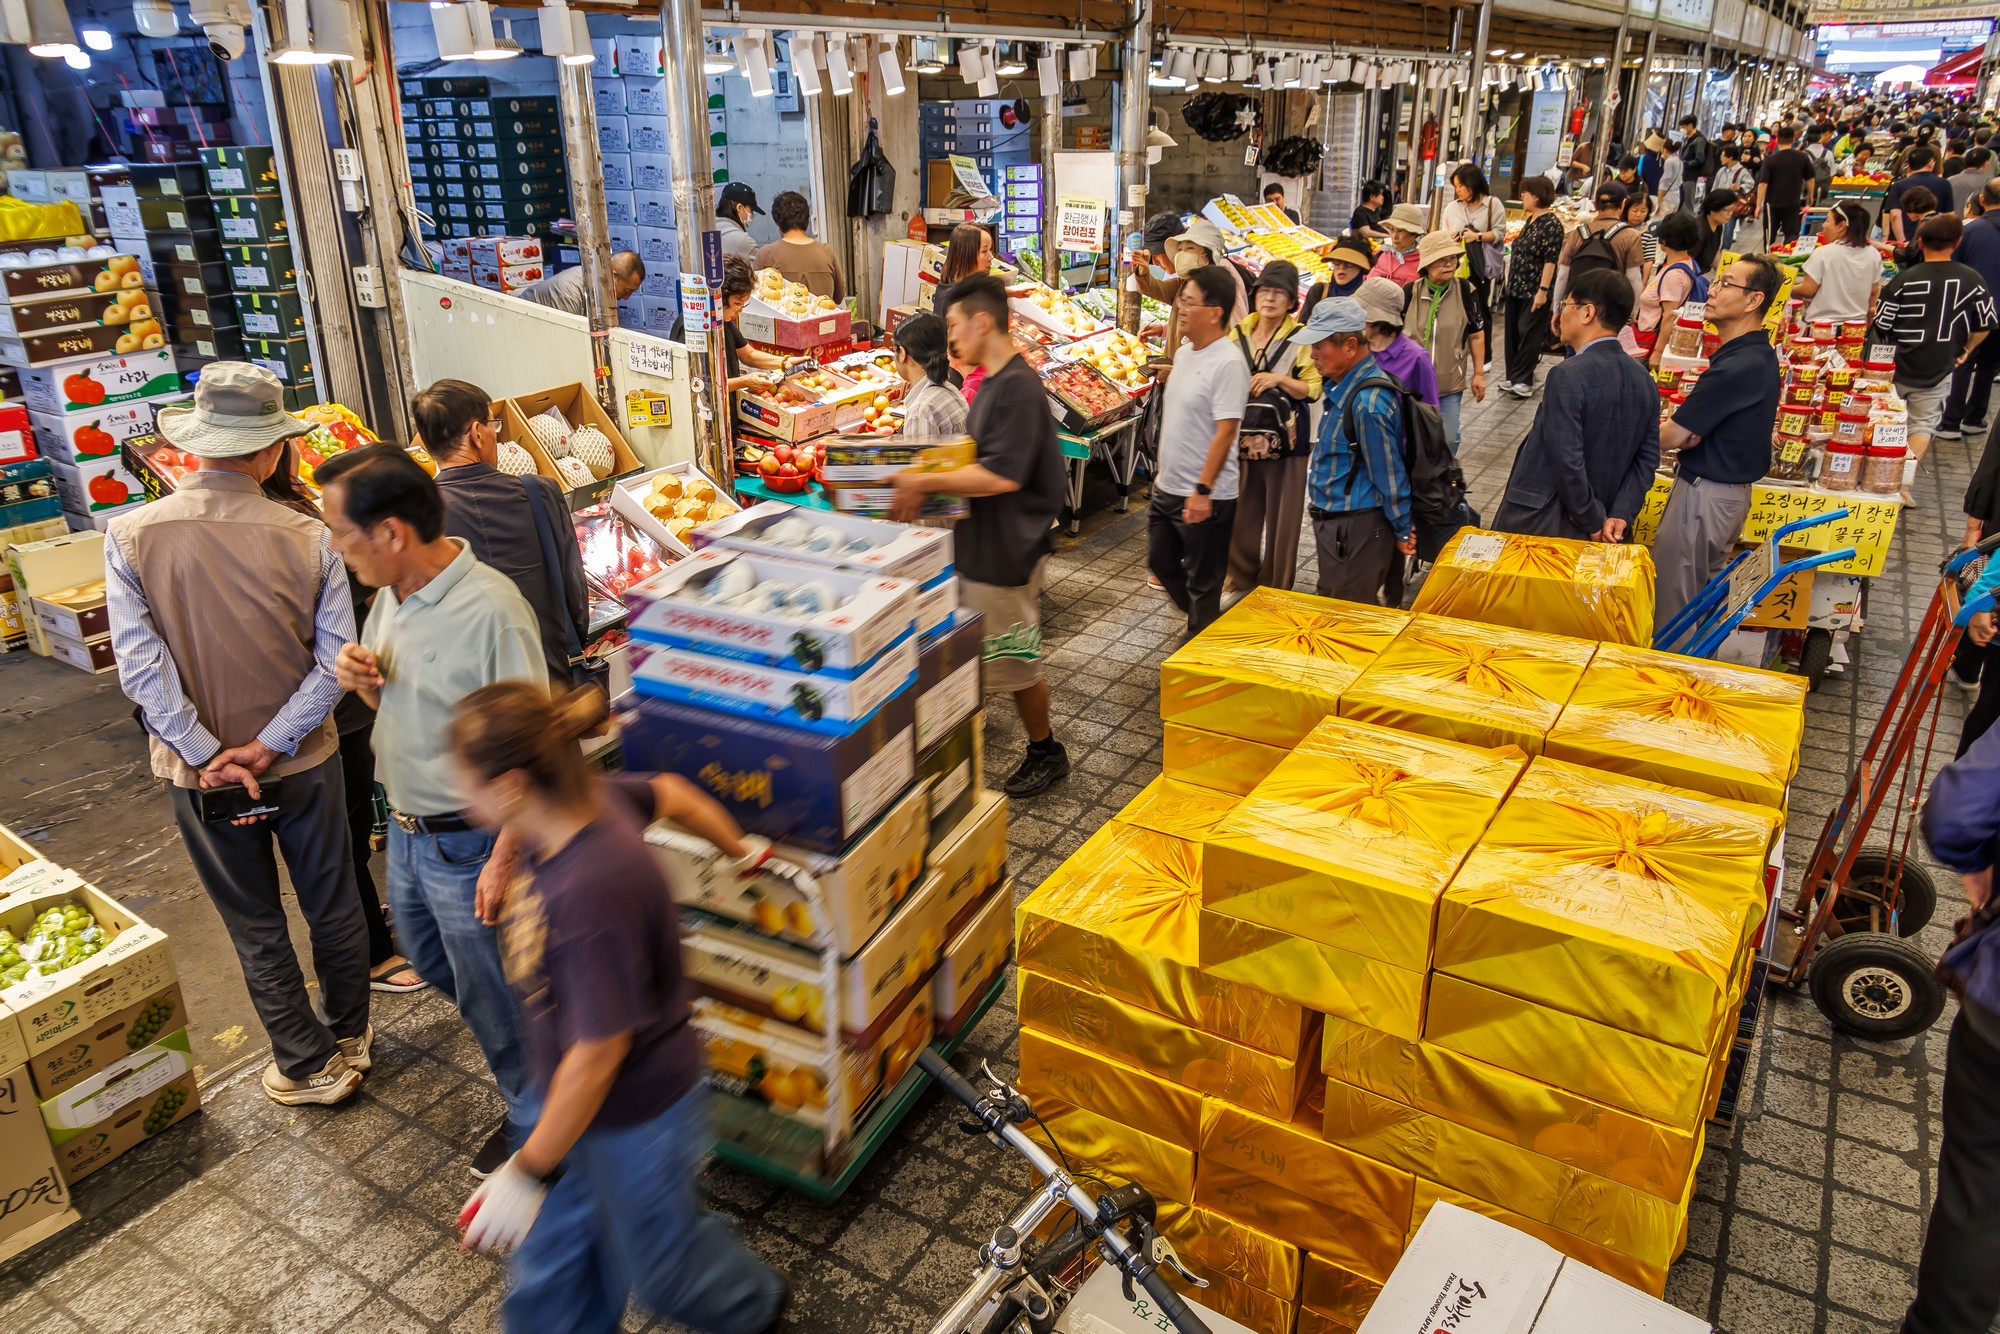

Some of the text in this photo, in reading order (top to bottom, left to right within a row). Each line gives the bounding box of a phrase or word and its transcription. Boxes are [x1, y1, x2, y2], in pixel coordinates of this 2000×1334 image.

[1064, 212, 1098, 226] 환급행사
[1063, 225, 1096, 238] 참여점포
[119, 370, 149, 384] 사과
[1760, 492, 1826, 513] 오징어젓
[1751, 510, 1788, 525] 파김치
[1866, 504, 1896, 524] 창란
[1754, 528, 1810, 547] 배김치
[1835, 527, 1882, 547] 꼴뚜기
[1442, 1272, 1458, 1293] FRESH
[1429, 1291, 1448, 1318] YEONGJU
